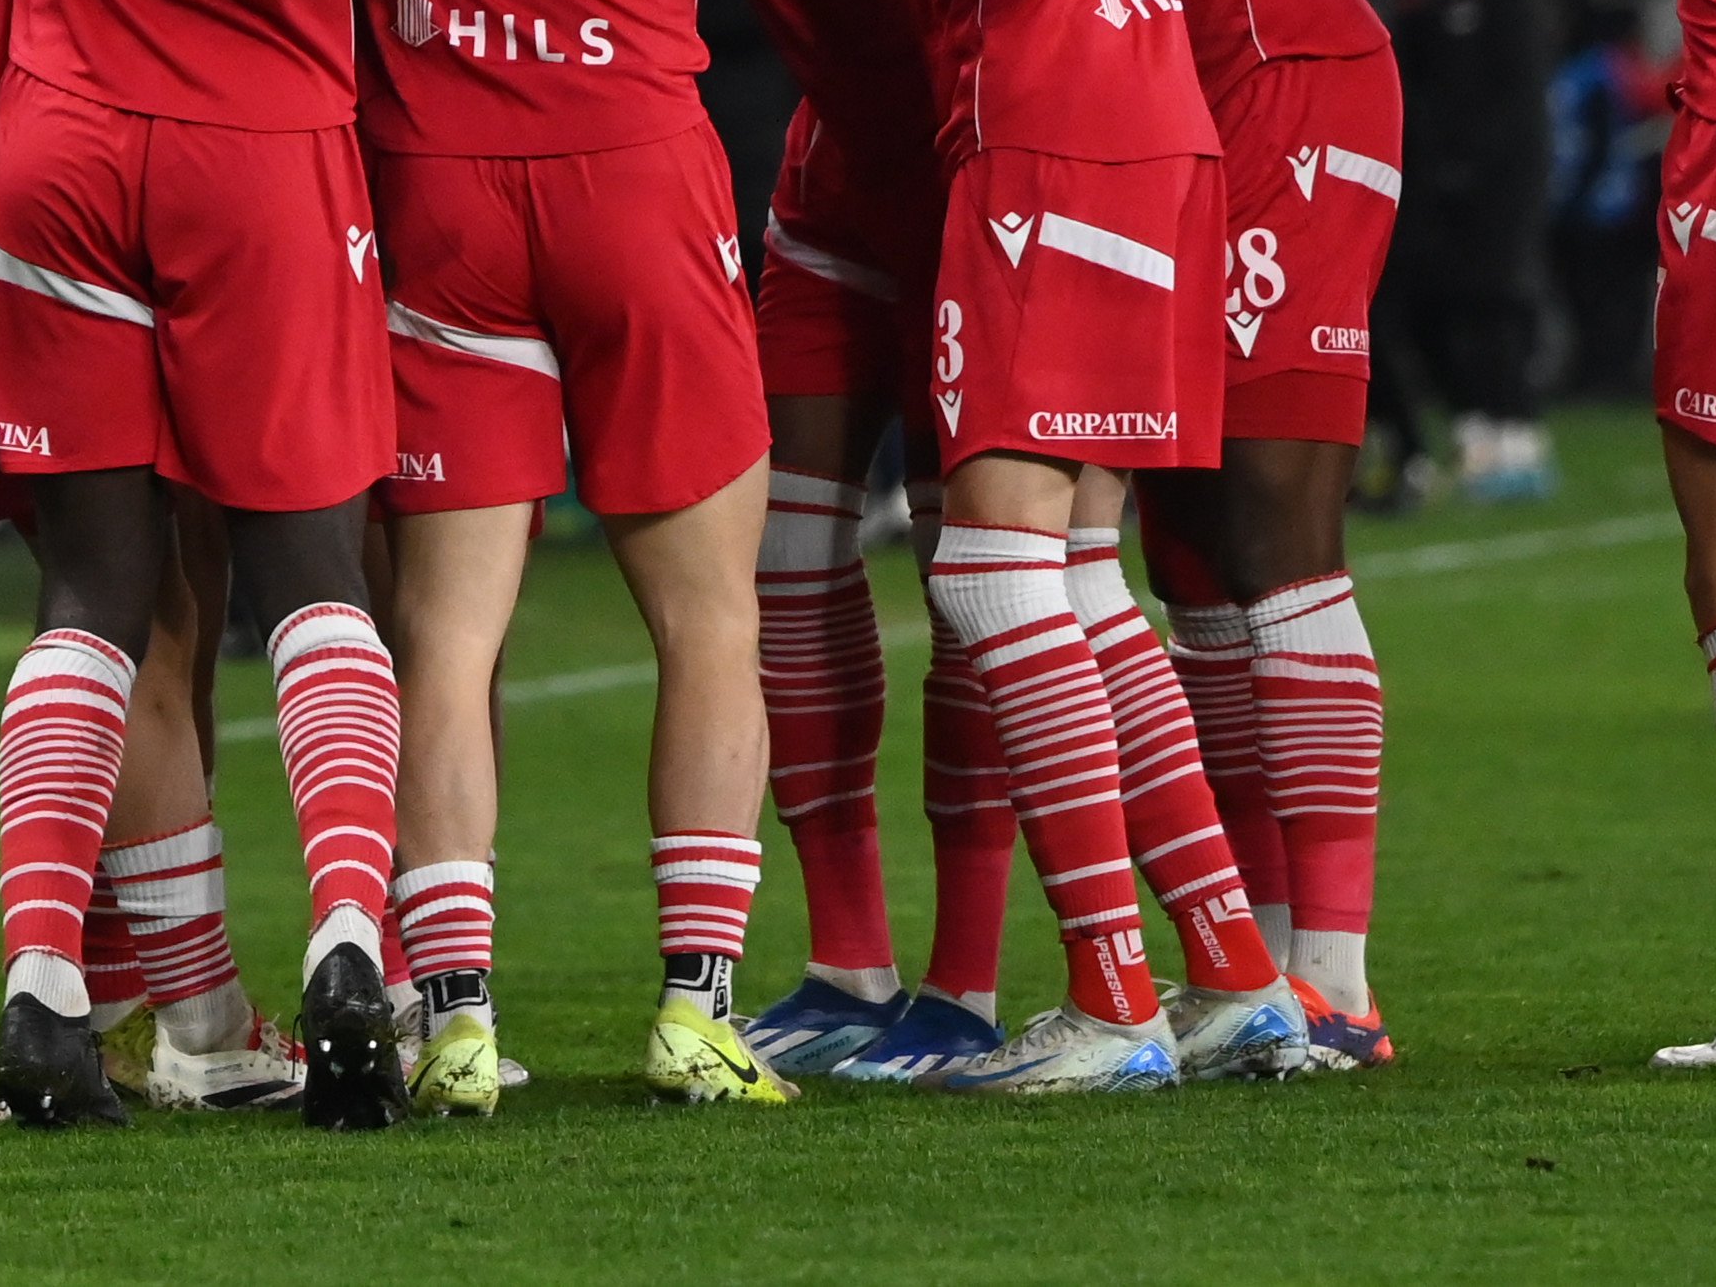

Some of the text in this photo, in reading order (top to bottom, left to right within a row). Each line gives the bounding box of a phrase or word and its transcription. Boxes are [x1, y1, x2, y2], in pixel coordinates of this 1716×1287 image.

[448, 9, 615, 65] HILS
[936, 298, 964, 384] 3
[1027, 411, 1178, 441] CARPATINA
[1187, 905, 1231, 968] PEDESIGN
